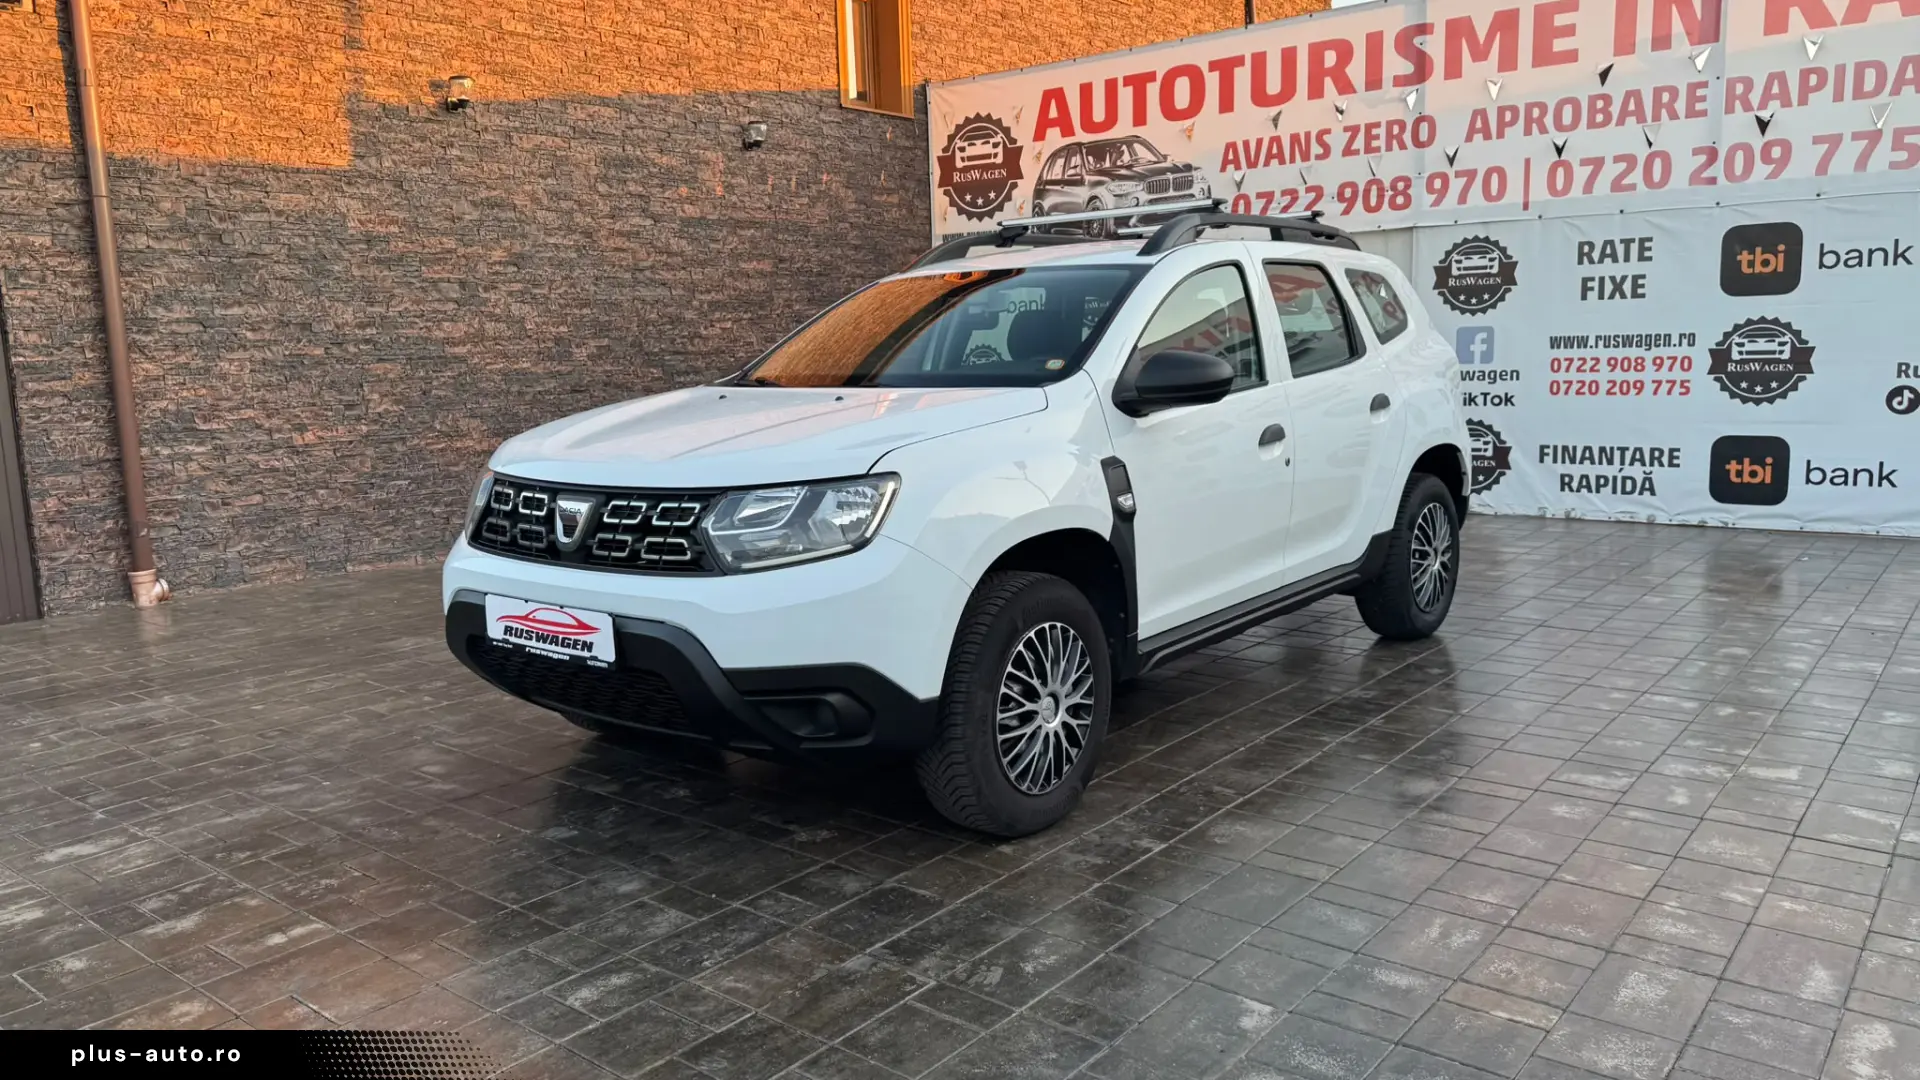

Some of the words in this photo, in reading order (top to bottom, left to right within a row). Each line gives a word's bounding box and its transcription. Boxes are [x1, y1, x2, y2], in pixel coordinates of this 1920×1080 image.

[1033, 0, 1580, 142] AUTOTURISME
[1613, 0, 1723, 57] IN
[1219, 128, 1333, 173] AVANS
[1342, 115, 1437, 157] ZERO
[1464, 80, 1710, 143] APROBARE
[1724, 54, 1920, 115] RAPIDA
[1336, 175, 1412, 217] 908
[1425, 165, 1508, 208] 970
[1546, 149, 1673, 198] 0720
[1688, 137, 1793, 187] 209
[1811, 125, 1920, 177] 775
[1577, 236, 1654, 265] RATE
[1737, 244, 1786, 275] tbi
[1817, 238, 1915, 270] bank
[1579, 273, 1647, 301] FIXE
[1549, 331, 1697, 350] www.ruswagen.ro
[1549, 356, 1601, 374] 0722
[1606, 356, 1647, 374] 908
[1651, 355, 1693, 373] 970
[1549, 379, 1600, 397] 0720
[1605, 379, 1646, 397] 209
[1651, 379, 1692, 397] 775
[1725, 453, 1773, 484] tbi
[1805, 459, 1899, 489] bank
[503, 624, 594, 653] RUSWAGEN
